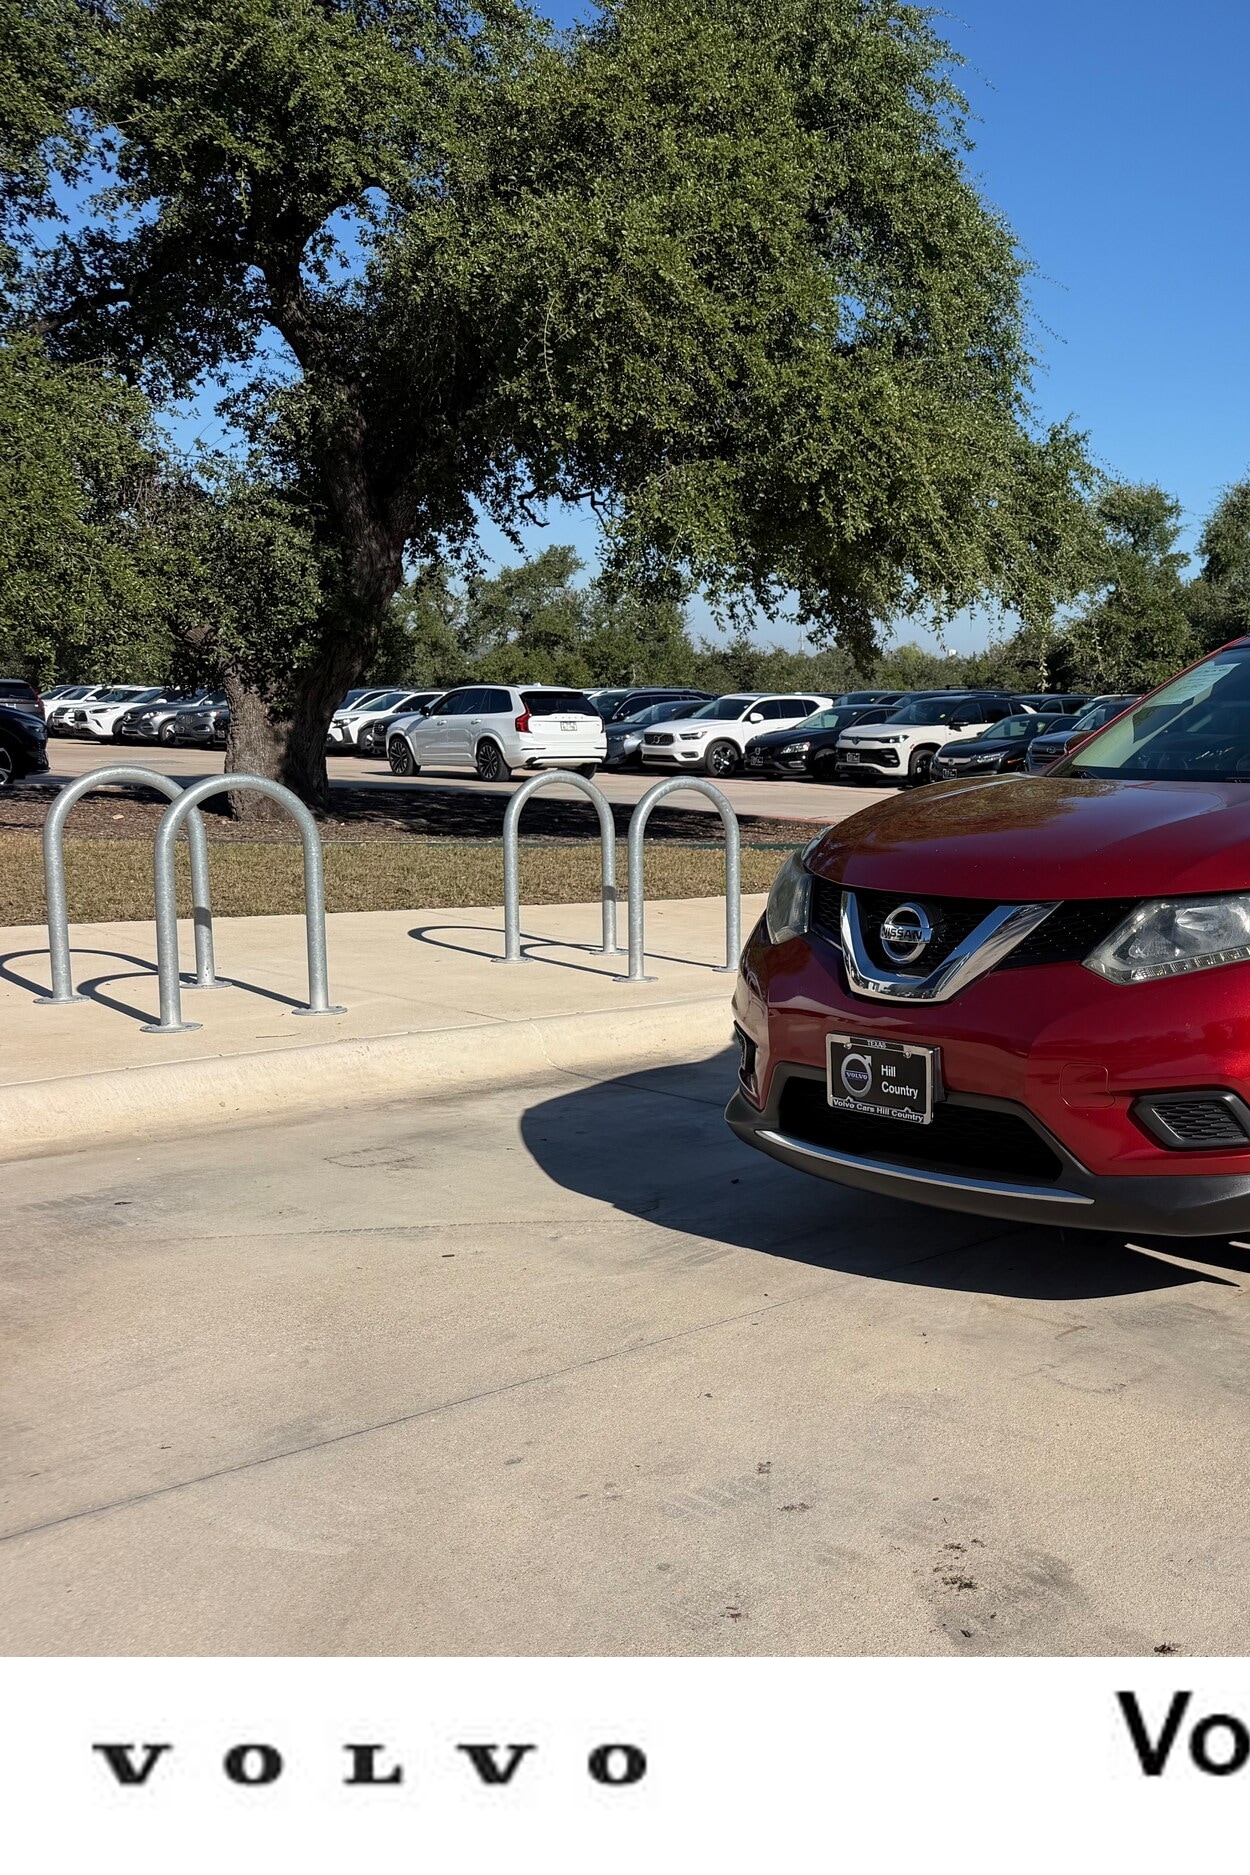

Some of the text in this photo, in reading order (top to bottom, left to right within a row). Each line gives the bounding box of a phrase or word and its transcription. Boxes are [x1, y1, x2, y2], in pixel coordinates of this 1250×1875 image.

[881, 926, 923, 940] NISSAN
[867, 1039, 887, 1049] TEXAS
[845, 1071, 868, 1080] VOLVO
[881, 1064, 896, 1077] Hill
[881, 1081, 919, 1099] Country
[833, 1099, 924, 1123] Volvo Cars Hill Country
